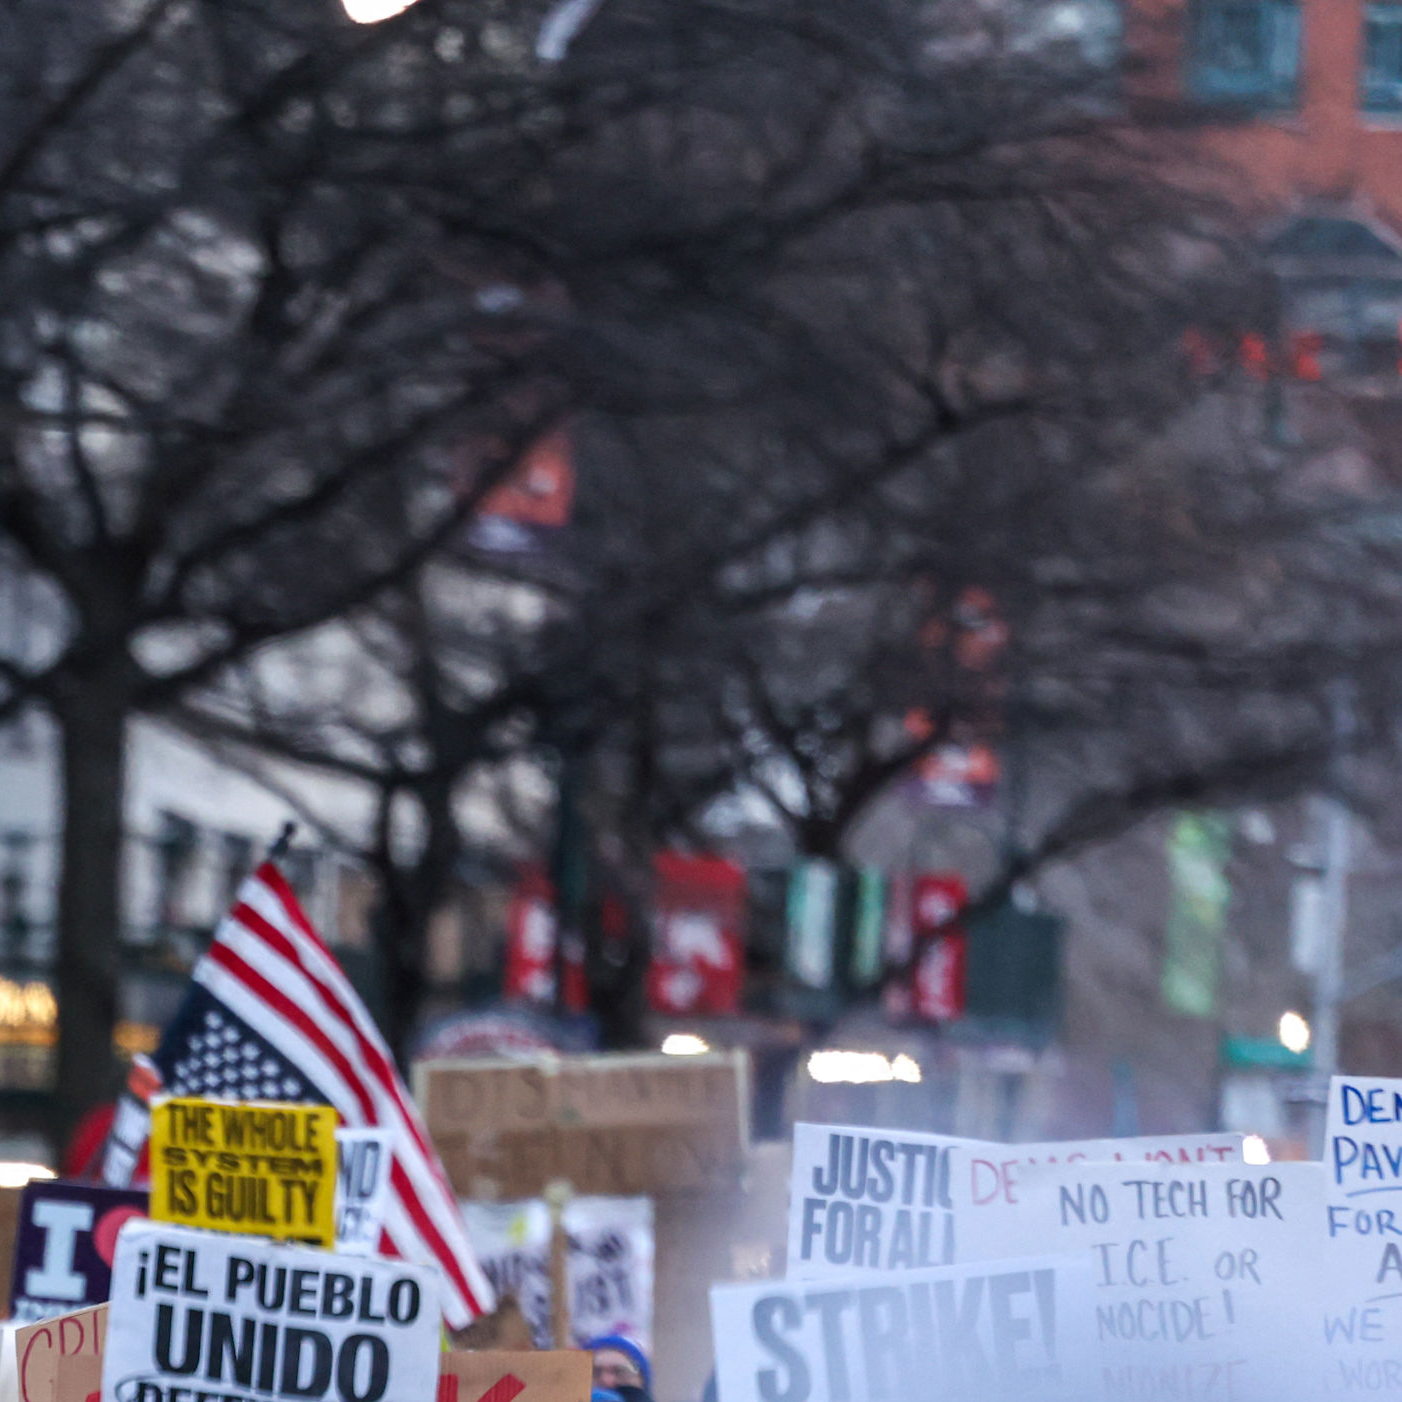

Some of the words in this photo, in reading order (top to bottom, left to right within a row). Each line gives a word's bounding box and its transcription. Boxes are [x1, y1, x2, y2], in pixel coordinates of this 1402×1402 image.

[167, 1104, 214, 1146] THE
[220, 1107, 319, 1153] WHOLE
[161, 1147, 323, 1176] SYSTEM
[167, 1170, 196, 1217] IS
[205, 1171, 319, 1226] GUILTY
[1060, 1183, 1110, 1226] NO
[1123, 1180, 1208, 1220] TECH
[1225, 1176, 1284, 1221] FOR
[25, 1199, 95, 1301] I
[800, 1198, 884, 1267] FOR
[136, 1243, 210, 1299] ¡EL
[226, 1255, 421, 1327] PUEBLO
[1214, 1248, 1261, 1285] OR
[1324, 1307, 1384, 1345] WE
